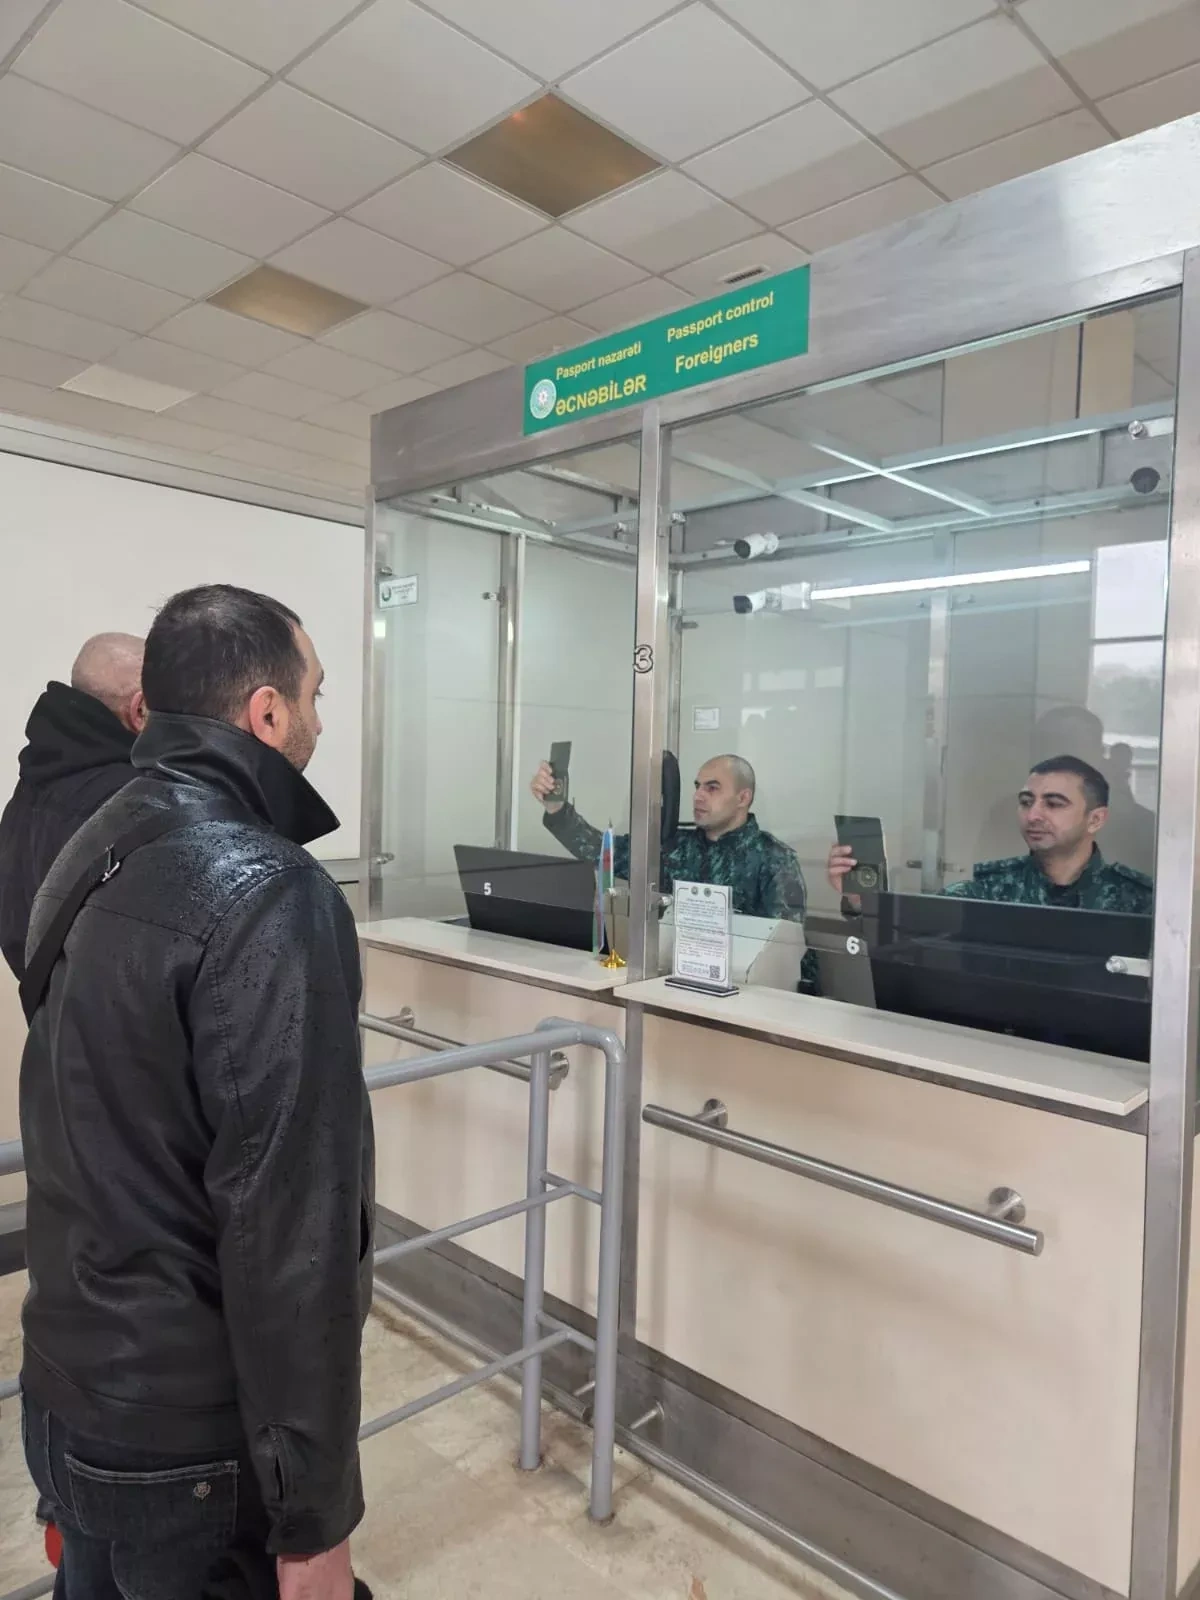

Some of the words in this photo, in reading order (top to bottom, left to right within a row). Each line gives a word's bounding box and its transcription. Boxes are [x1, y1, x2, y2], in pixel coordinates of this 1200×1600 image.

[667, 309, 723, 343] Passport
[725, 290, 774, 321] control
[556, 356, 596, 380] Pasport
[675, 333, 759, 374] Foreigners
[555, 373, 647, 416] ƏCNƏBİLƏR
[633, 644, 653, 673] 3
[483, 882, 492, 896] 5
[846, 935, 860, 955] 6
